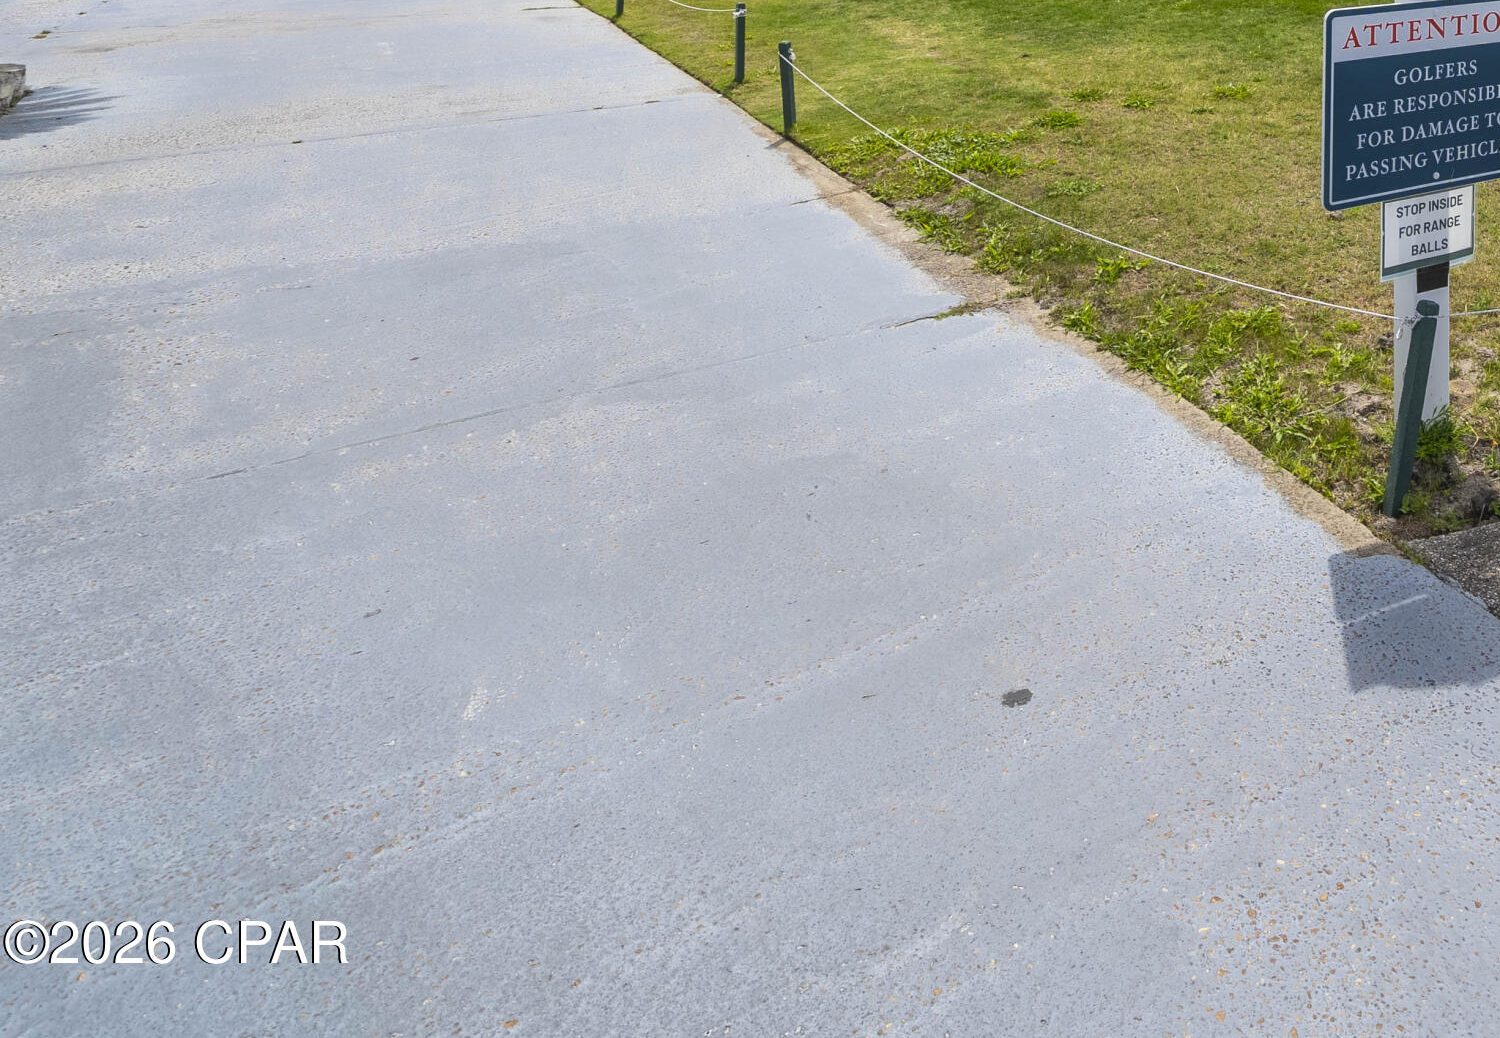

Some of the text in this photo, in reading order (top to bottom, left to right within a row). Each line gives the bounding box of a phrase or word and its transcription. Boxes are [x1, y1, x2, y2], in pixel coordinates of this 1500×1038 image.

[1394, 59, 1478, 86] GOLFERS
[1349, 101, 1387, 122] ARE
[1356, 129, 1396, 150] FOR
[1401, 116, 1480, 142] DAMAGE
[1345, 151, 1428, 181] PASSING
[1396, 194, 1463, 219] STOP INSIDE
[1399, 215, 1461, 239] FOR RANGE
[1411, 238, 1449, 256] BALLS
